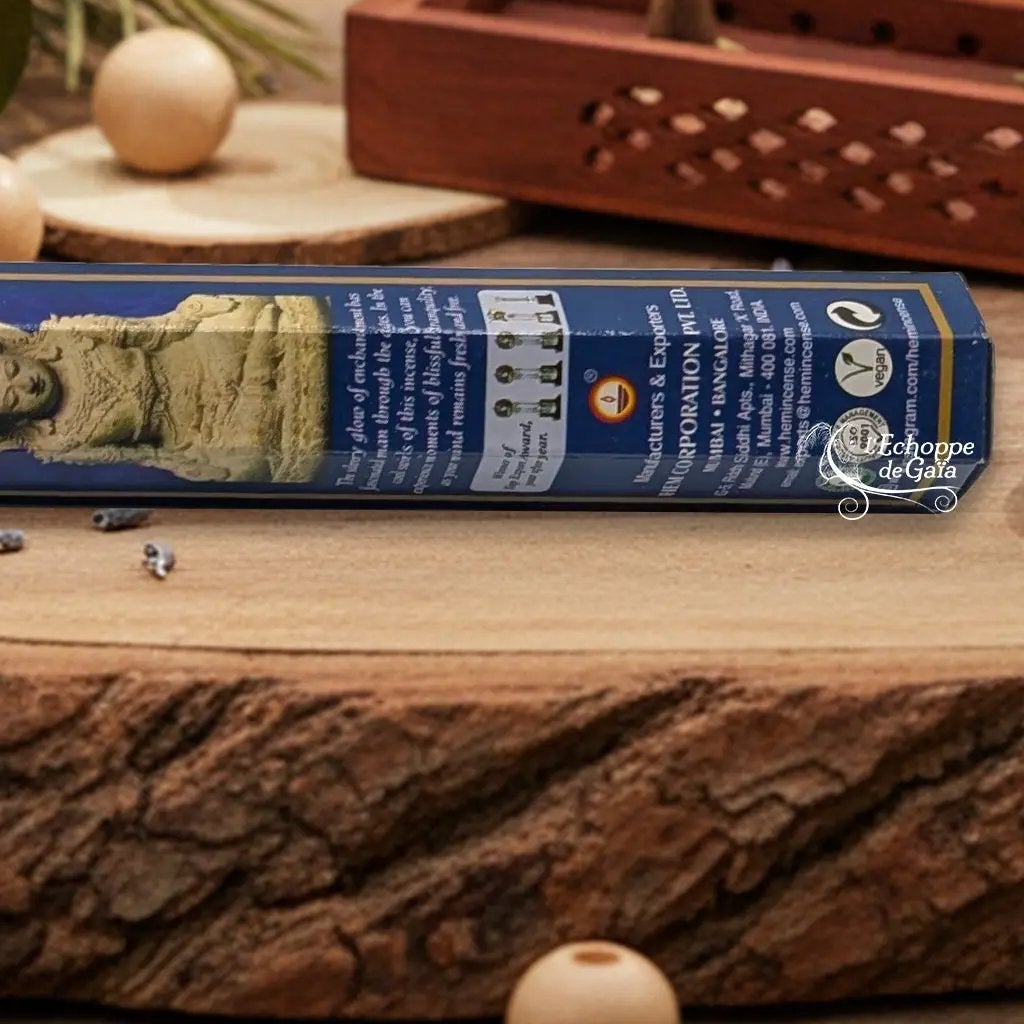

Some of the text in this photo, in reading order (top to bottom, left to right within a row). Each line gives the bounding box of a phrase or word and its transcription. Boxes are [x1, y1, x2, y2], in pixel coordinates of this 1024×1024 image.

[668, 287, 692, 310] LTD.
[373, 342, 392, 364] the
[422, 334, 446, 387] blissful
[738, 323, 759, 379] Mithagar
[760, 355, 775, 381] 400
[874, 347, 888, 389] vegan
[347, 385, 371, 403] of
[372, 367, 395, 425] through
[395, 395, 415, 423] this
[422, 388, 444, 406] of
[449, 370, 466, 426] remains
[633, 304, 672, 483] Manufacturers & Exporters
[671, 342, 702, 476] CORPORATION
[702, 317, 730, 473] MUMBAI BANGALORE
[775, 327, 797, 469] www.hemincense.com
[346, 406, 368, 443] glow
[395, 424, 418, 441] of
[421, 408, 440, 463] moments
[756, 392, 775, 448] Mumbai
[859, 423, 869, 450] 9001
[375, 429, 390, 459] man
[445, 430, 464, 463] mind
[501, 442, 518, 459] of
[519, 420, 533, 460] Award,
[537, 431, 550, 461] year.
[731, 423, 753, 464] Siddhi
